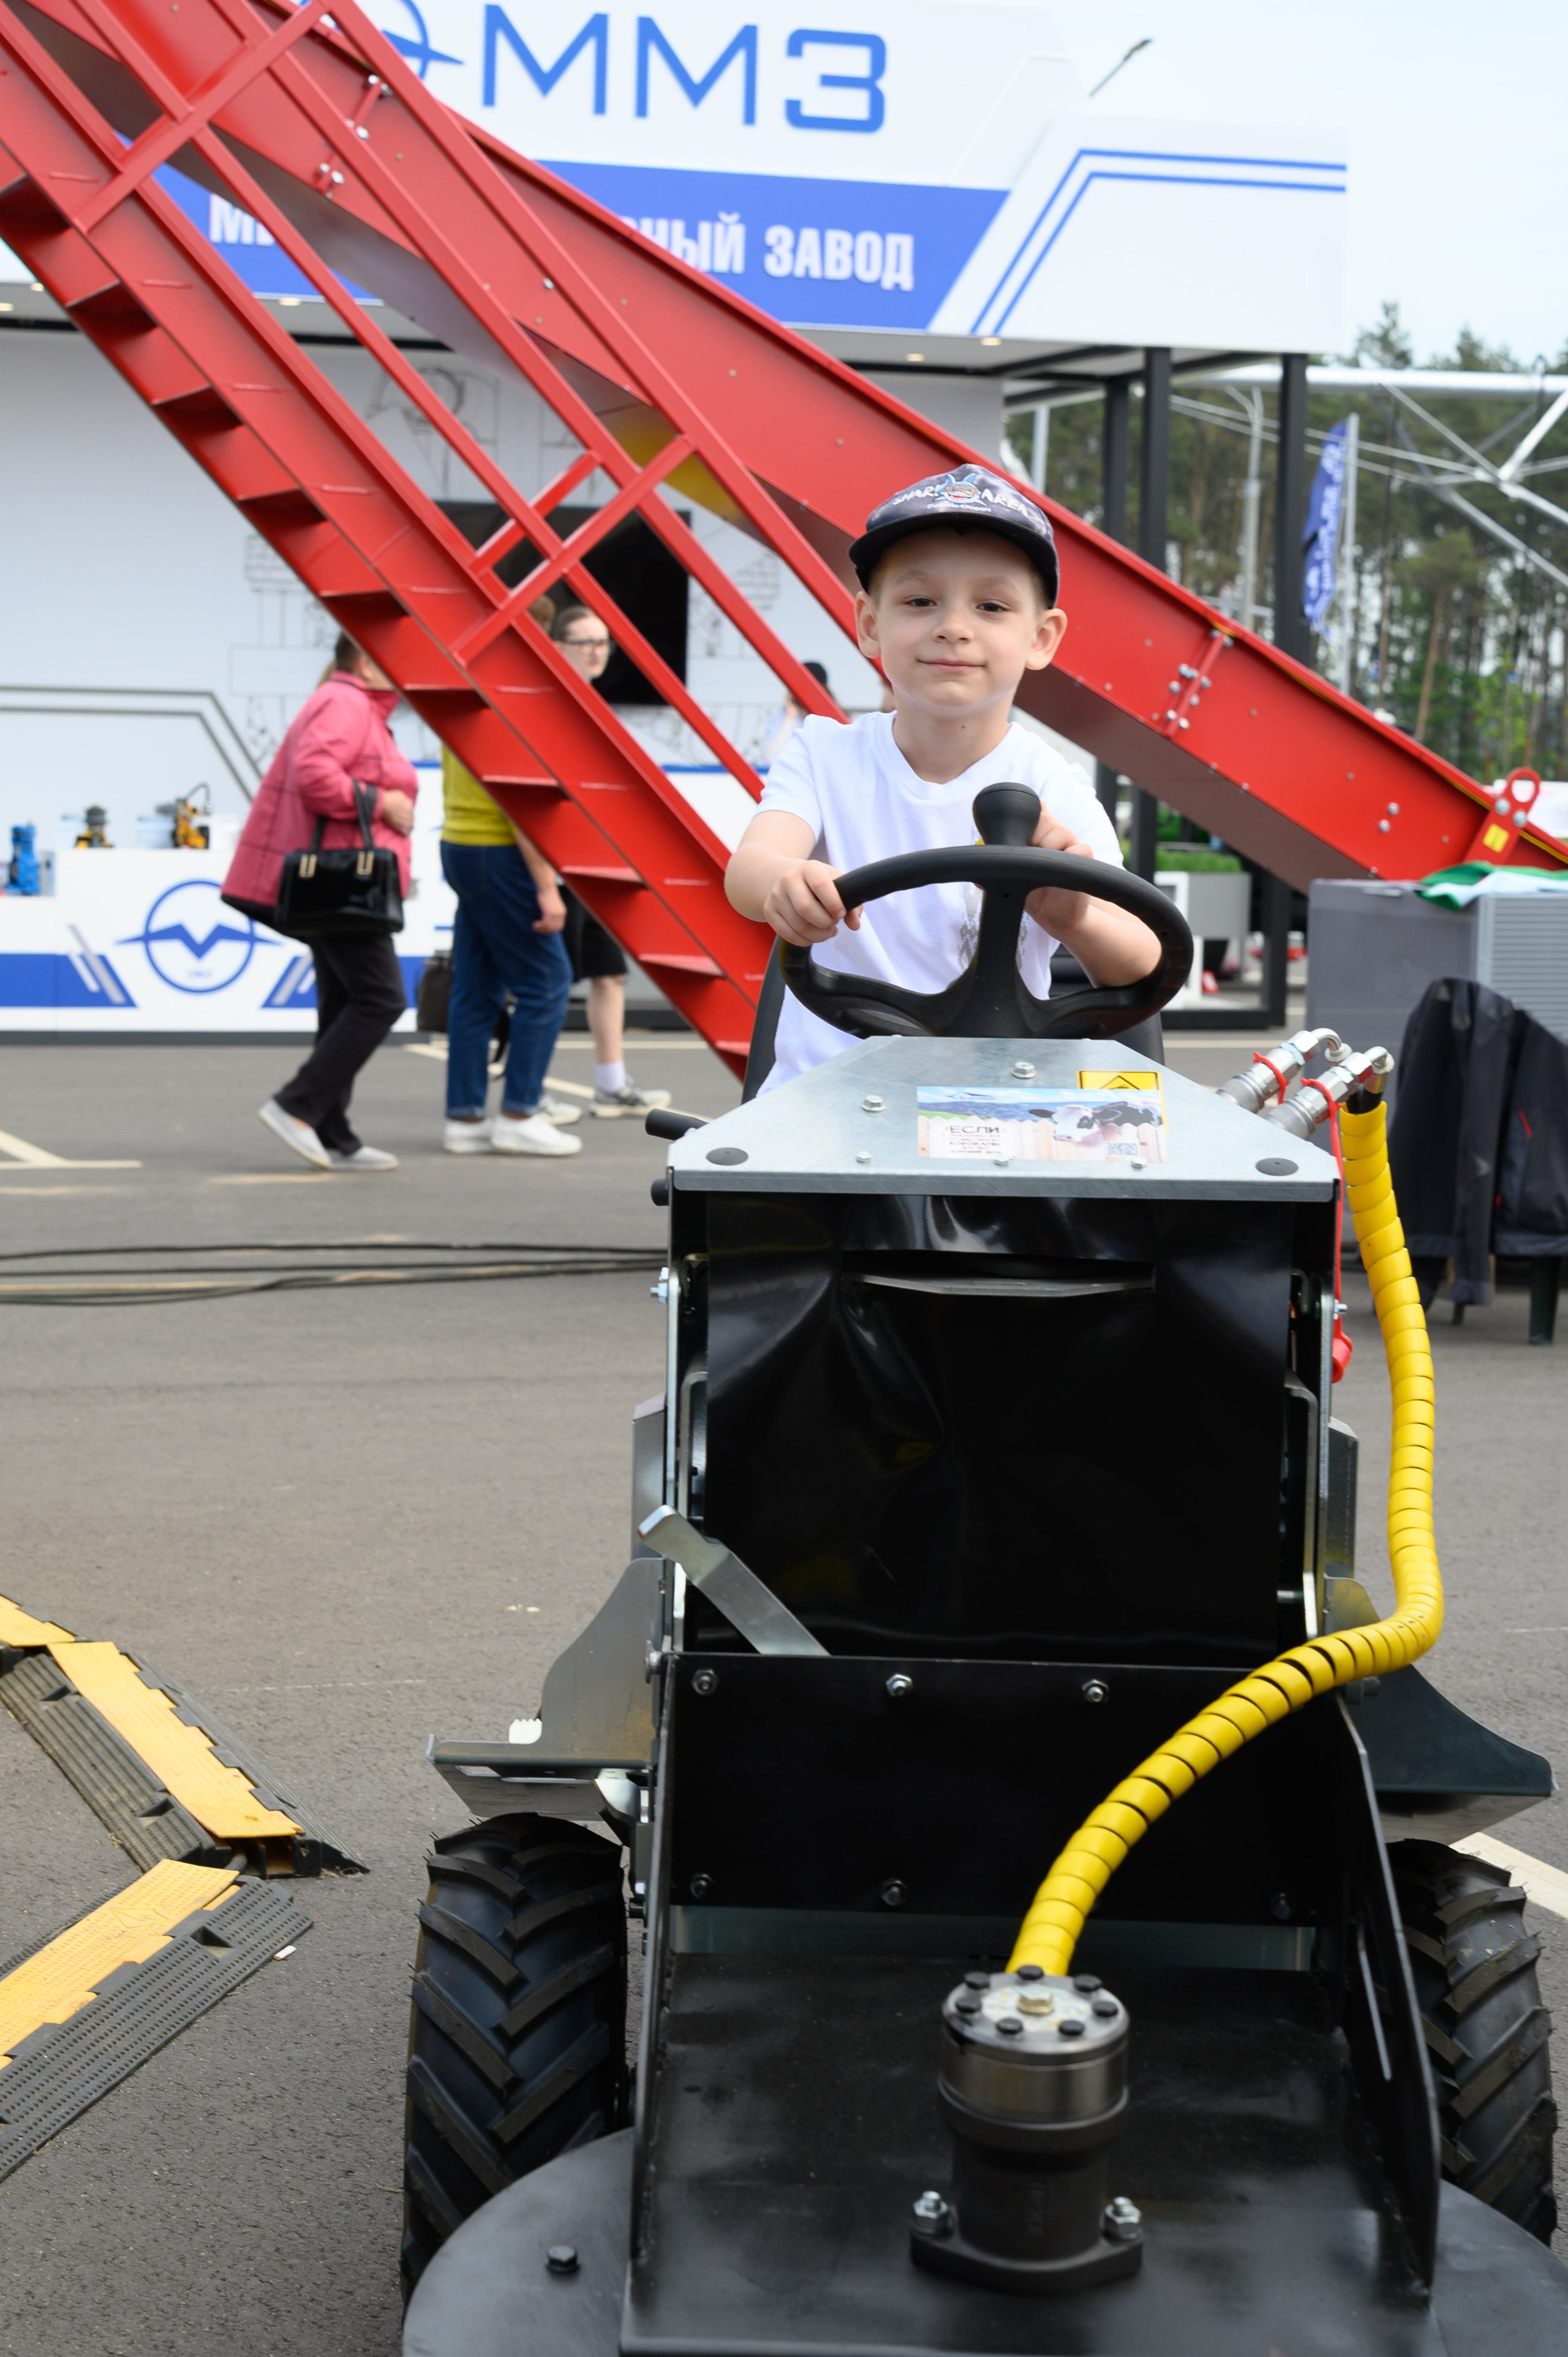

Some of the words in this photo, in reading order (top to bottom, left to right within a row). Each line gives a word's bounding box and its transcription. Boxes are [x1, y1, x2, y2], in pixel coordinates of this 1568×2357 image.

[482, 2, 888, 134] ММЗ
[622, 211, 745, 274] НЫЙ
[763, 224, 914, 292] ЗАВОД
[981, 488, 1028, 518] AREA
